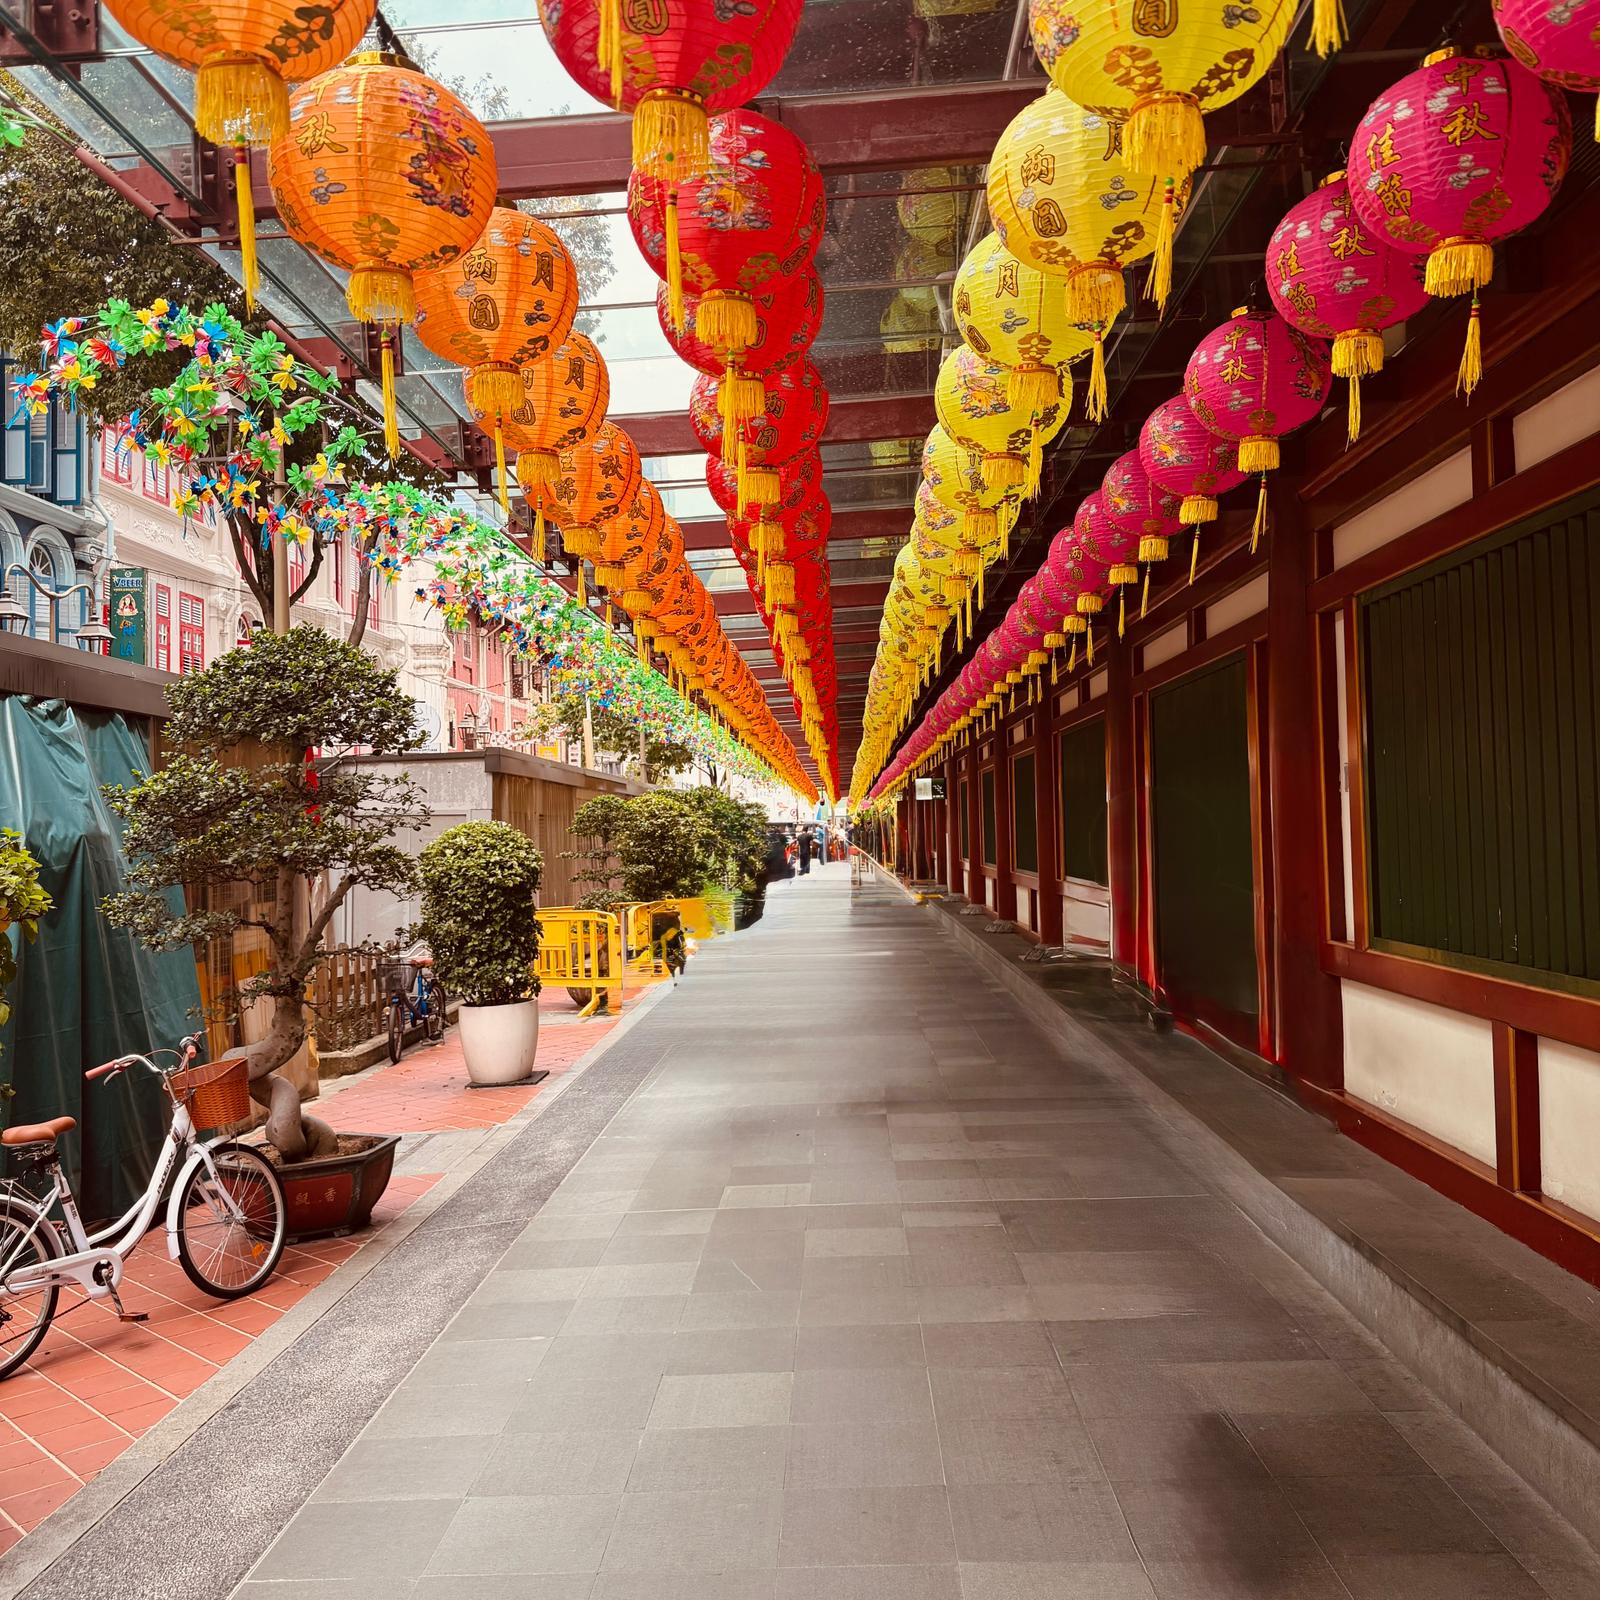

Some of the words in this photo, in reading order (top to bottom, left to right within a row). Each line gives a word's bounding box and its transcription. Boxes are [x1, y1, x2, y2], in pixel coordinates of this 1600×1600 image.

[1441, 62, 1499, 146] 中秋
[1021, 144, 1068, 238] 兩圓
[1366, 122, 1413, 216] 佳節
[462, 247, 500, 331] 兩圓
[1276, 240, 1317, 315] 佳節
[1219, 325, 1256, 386] 中秋
